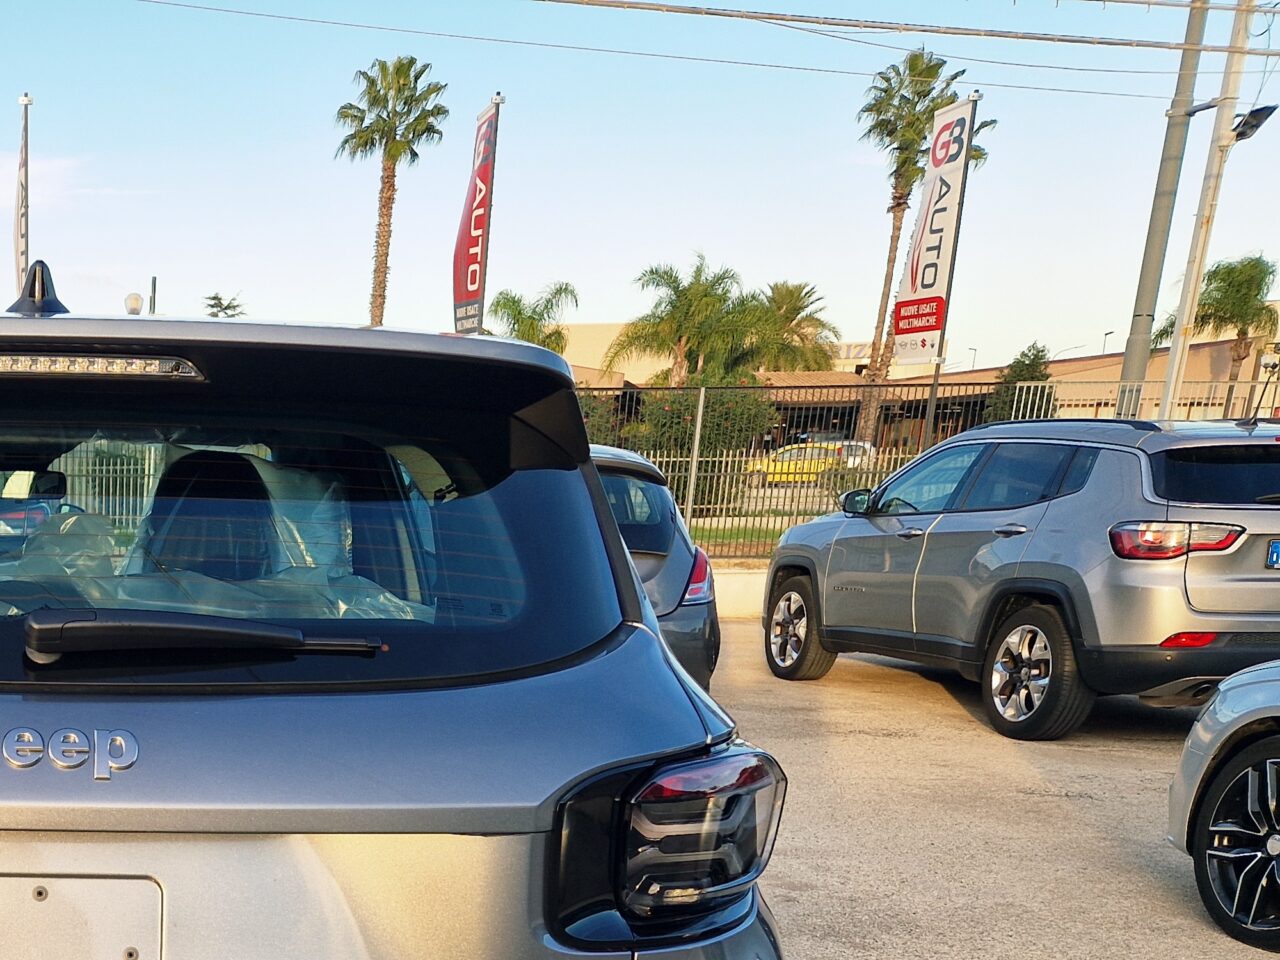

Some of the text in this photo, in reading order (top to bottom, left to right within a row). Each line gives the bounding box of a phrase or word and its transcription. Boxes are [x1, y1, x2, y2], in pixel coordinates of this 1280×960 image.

[467, 177, 486, 292] AUTO
[921, 176, 951, 289] AUTO
[899, 316, 937, 329] MULTIMARCHE
[919, 302, 937, 314] USATE
